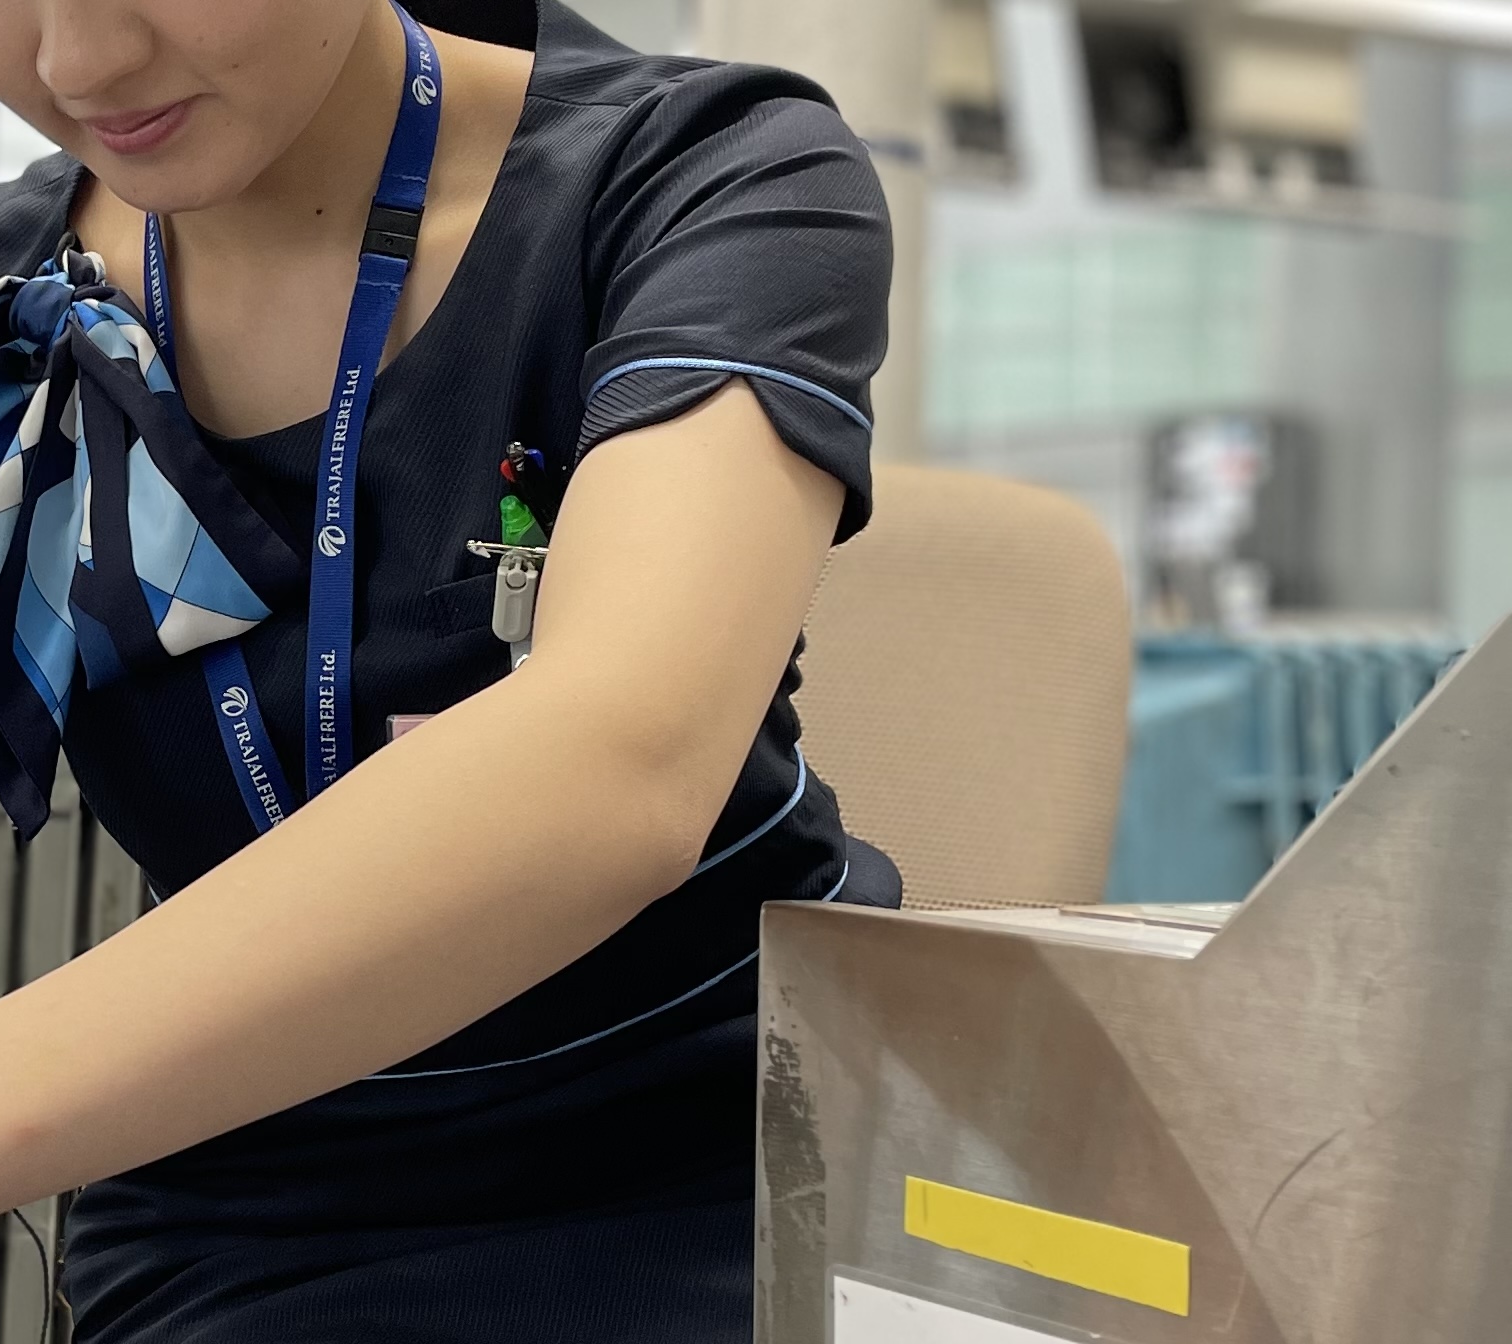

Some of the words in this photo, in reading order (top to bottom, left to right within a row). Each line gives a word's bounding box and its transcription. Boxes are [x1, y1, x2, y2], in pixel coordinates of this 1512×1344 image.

[326, 397, 354, 522] TRAJALFRERE
[342, 365, 362, 396] Ltd.
[319, 649, 336, 683] Ltd.
